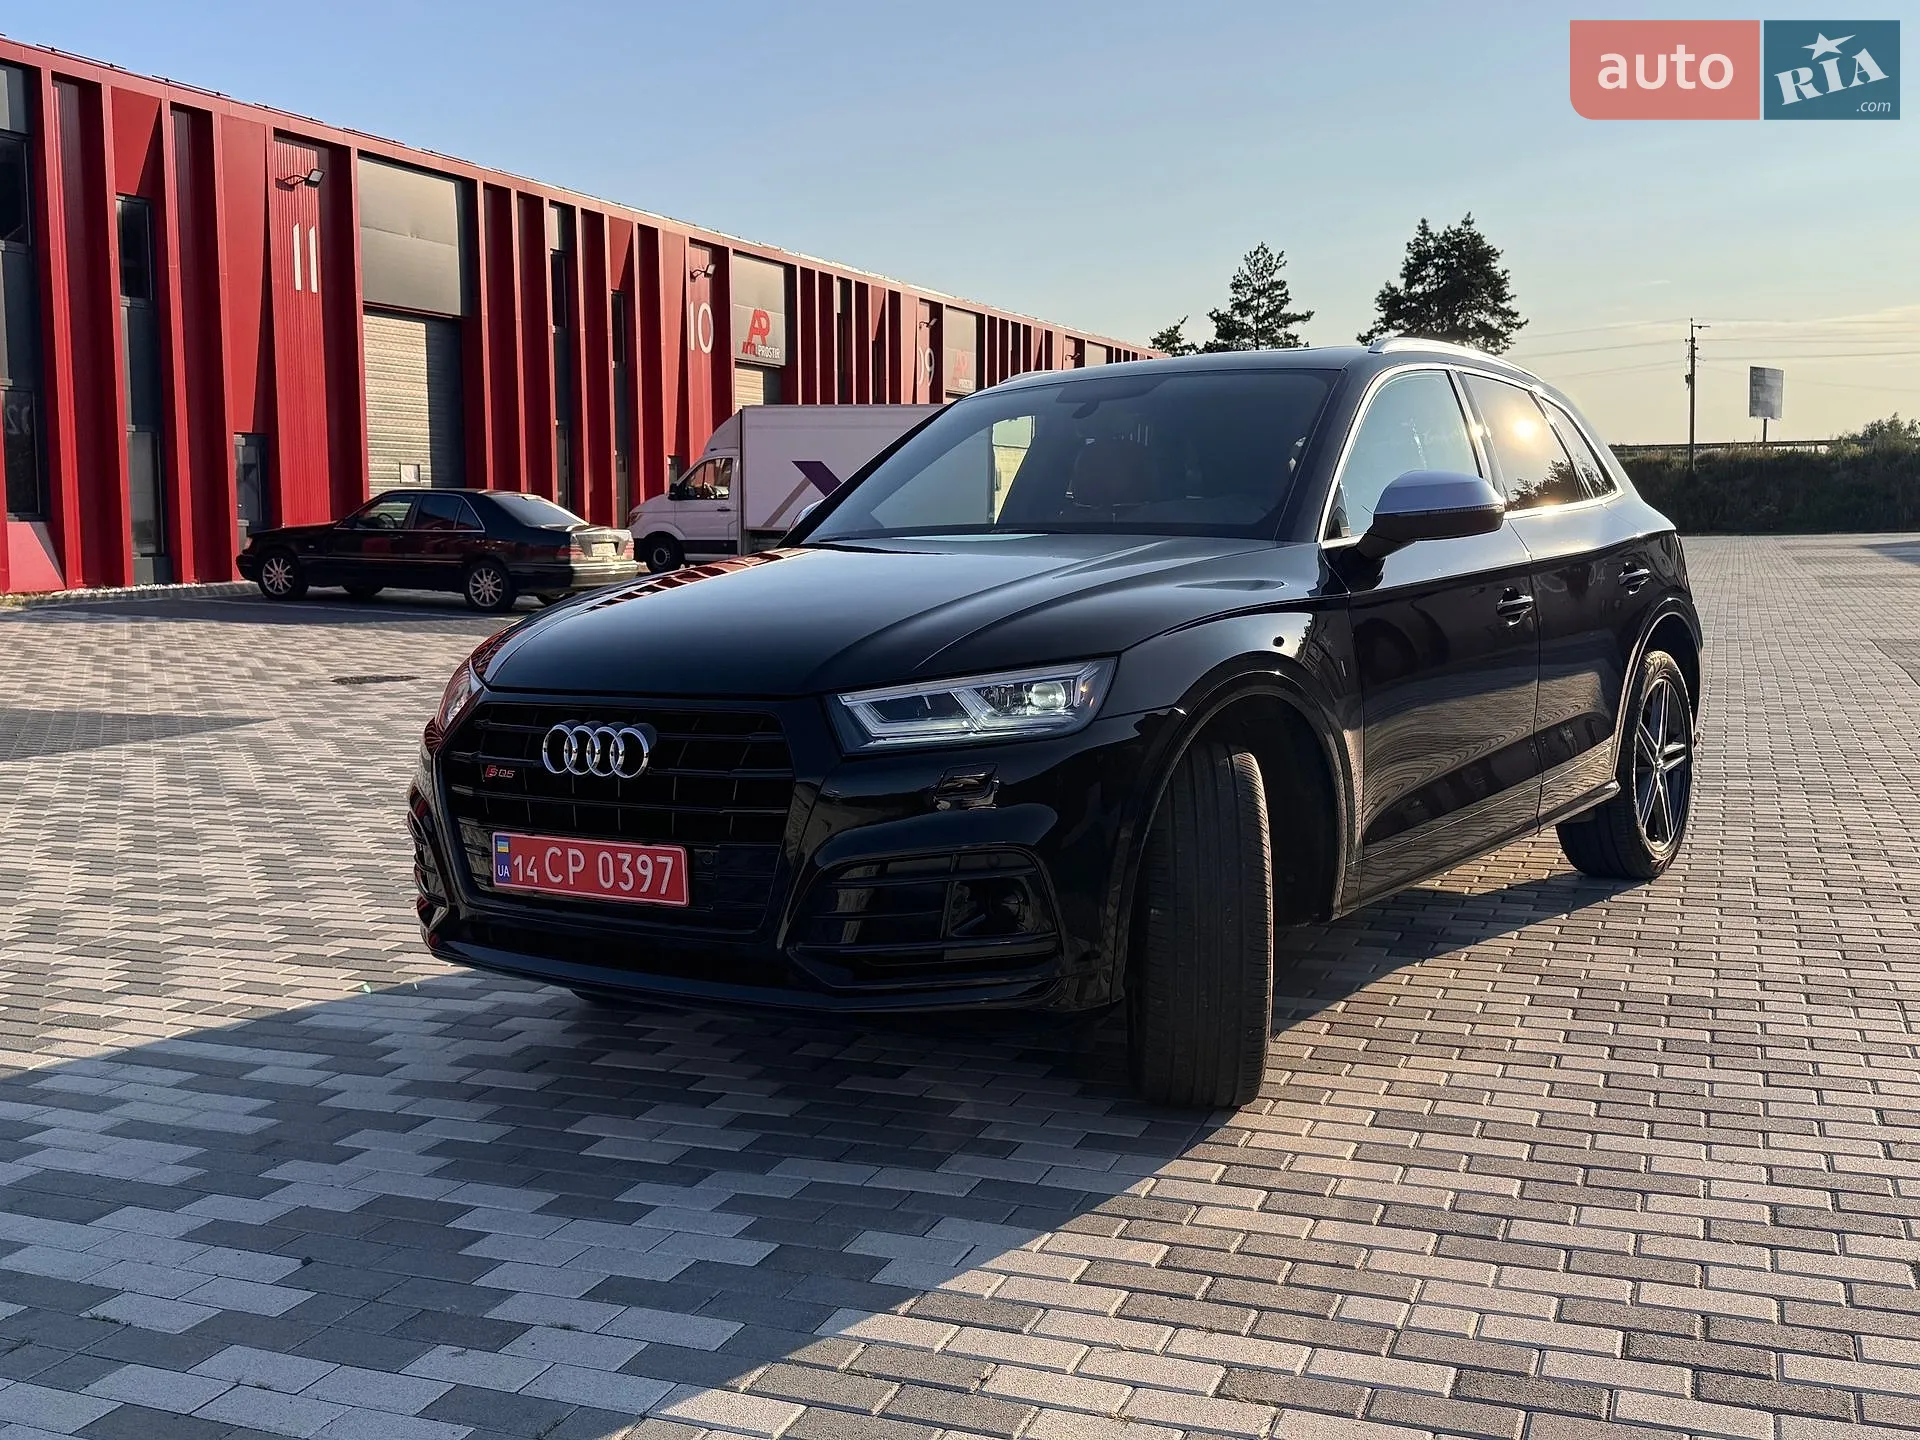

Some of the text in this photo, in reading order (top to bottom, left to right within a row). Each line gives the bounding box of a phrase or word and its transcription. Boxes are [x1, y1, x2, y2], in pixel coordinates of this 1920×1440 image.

[292, 222, 319, 294] 11
[690, 301, 714, 354] 10
[497, 864, 510, 878] UA
[597, 851, 674, 895] 0397
